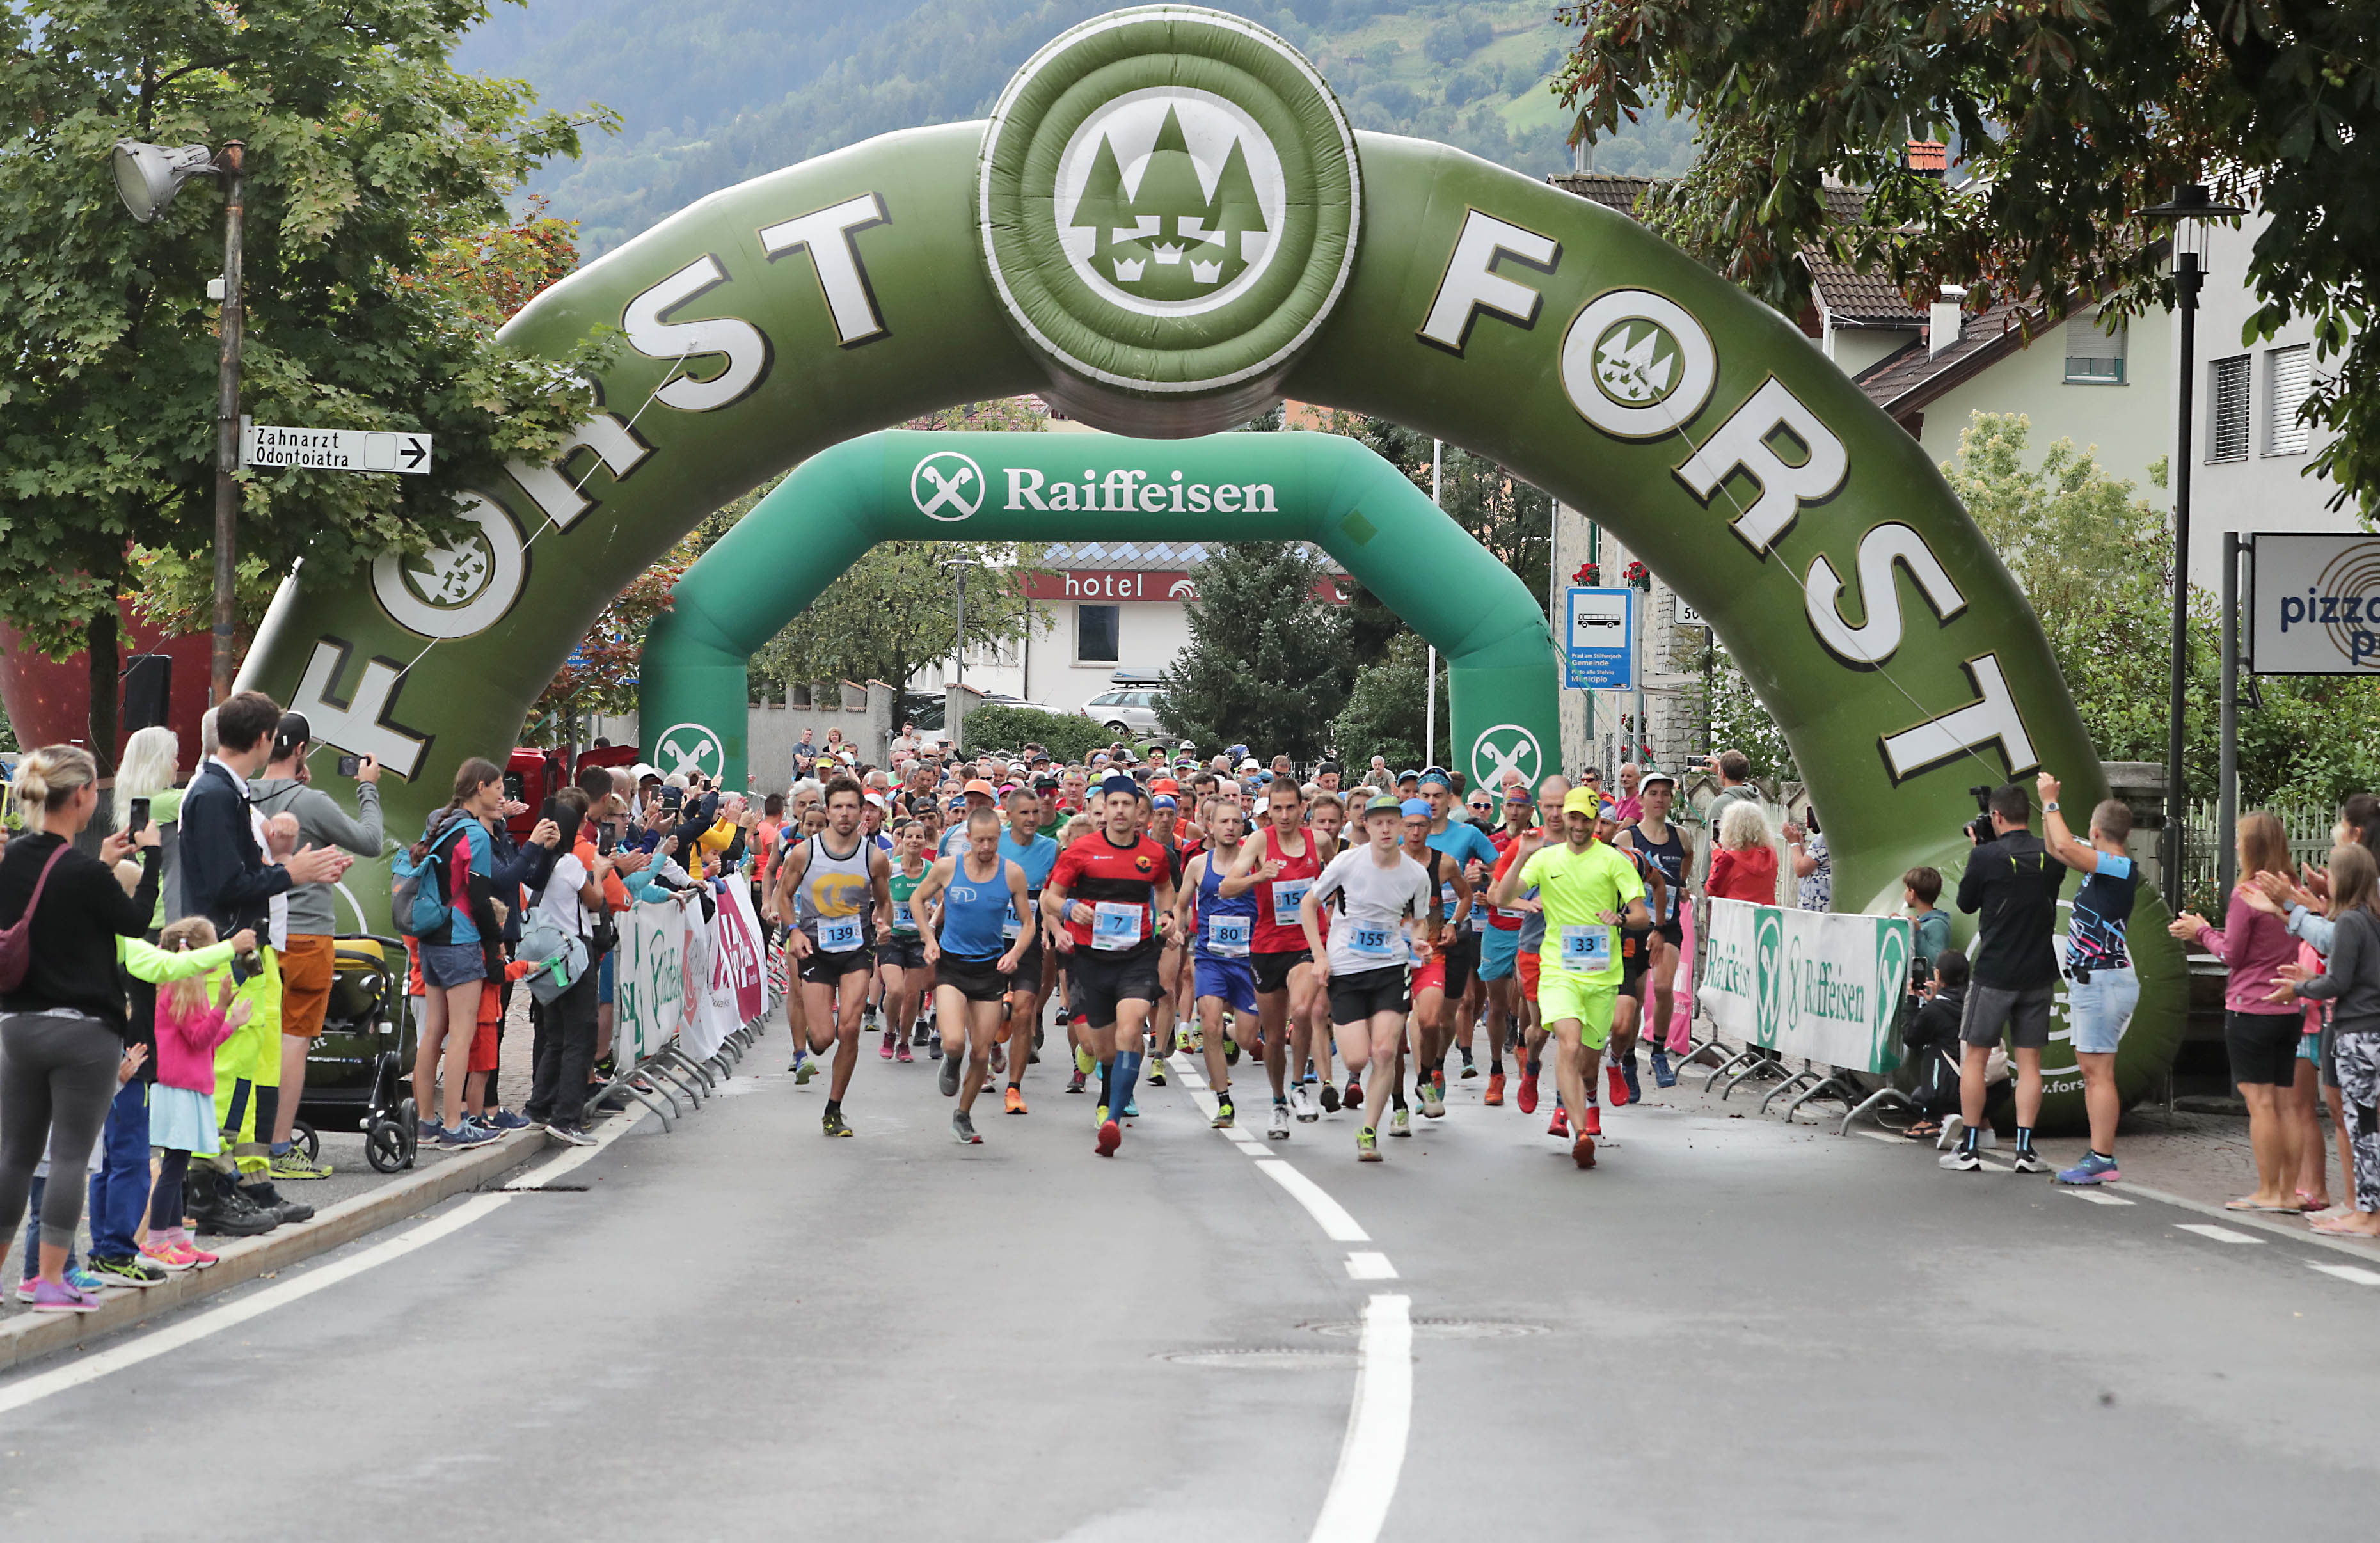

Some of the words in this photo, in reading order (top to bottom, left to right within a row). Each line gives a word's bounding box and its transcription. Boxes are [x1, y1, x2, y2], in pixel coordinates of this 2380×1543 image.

[257, 428, 338, 448] Zahnarzt
[257, 446, 348, 467] Odontoiatra
[1003, 468, 1278, 512] Raiffeisen
[1416, 205, 2040, 779] FORST
[1065, 573, 1143, 597] hotel
[2351, 630, 2380, 666] p
[1571, 676, 1608, 684] Municipio
[1284, 891, 1307, 905] 15
[1114, 917, 1123, 929] 7
[828, 927, 853, 940] 139
[1220, 928, 1238, 940] 80
[1360, 932, 1384, 946] 155
[1575, 938, 1594, 951] 33
[1804, 959, 1864, 1023] Rffeisen
